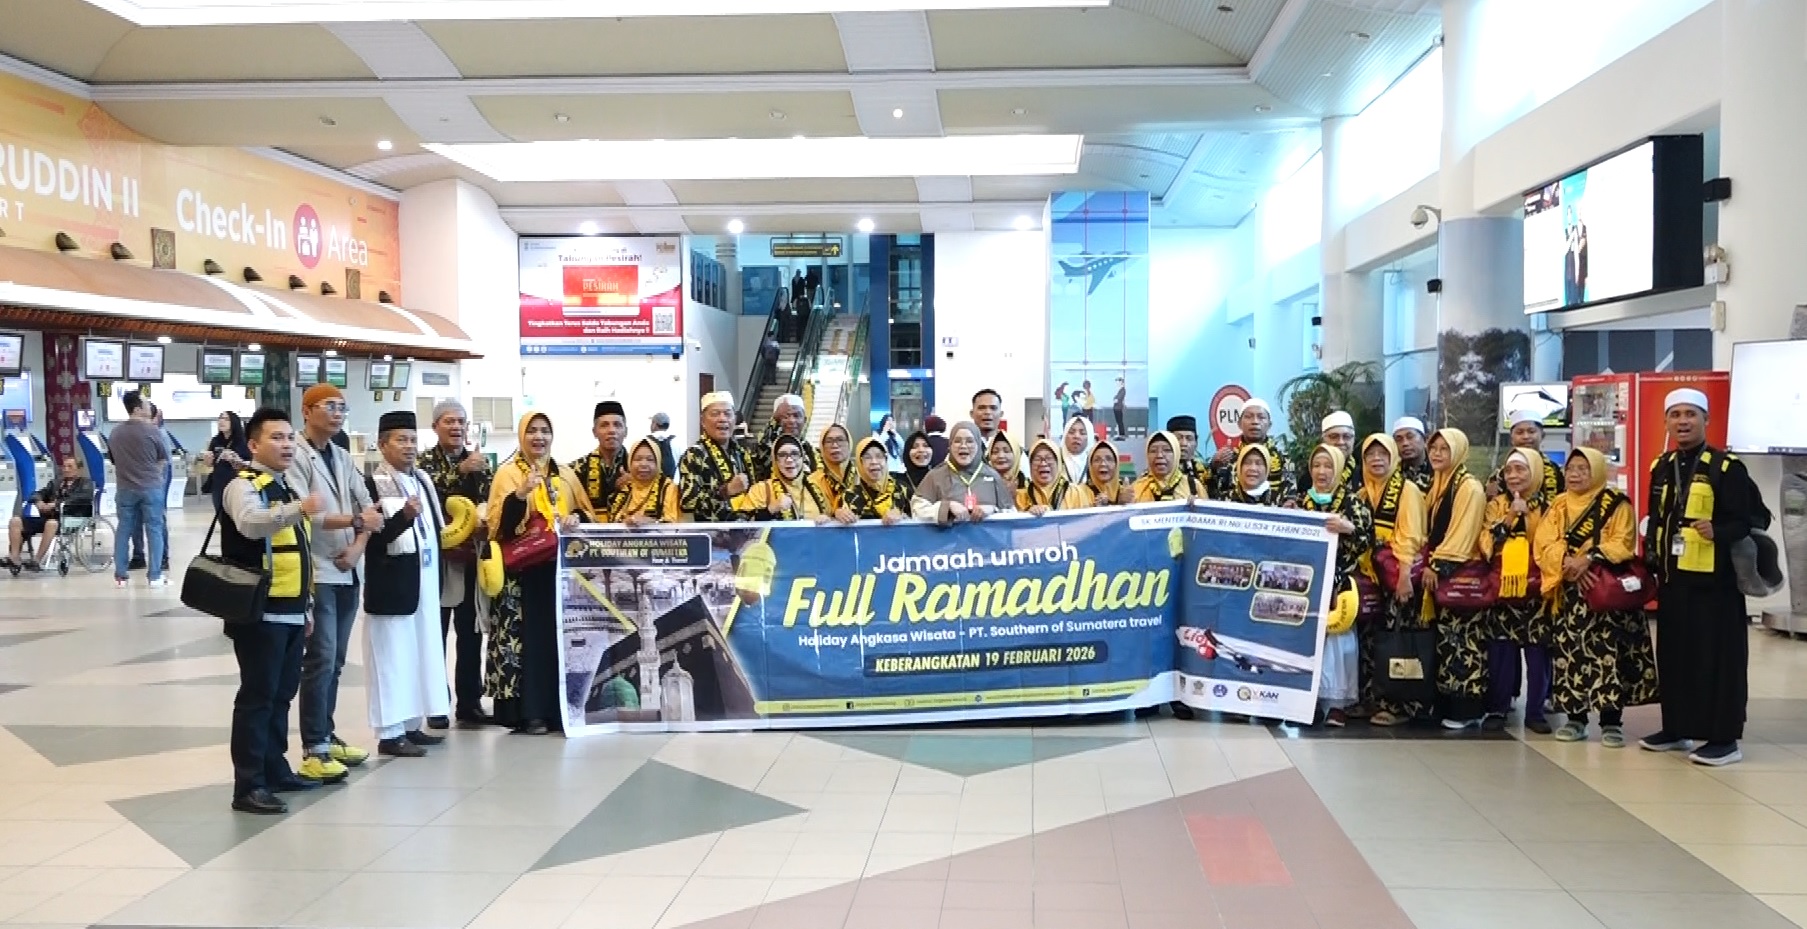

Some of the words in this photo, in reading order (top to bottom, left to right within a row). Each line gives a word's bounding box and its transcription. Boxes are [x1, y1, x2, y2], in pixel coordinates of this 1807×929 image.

[0, 142, 113, 212] UDDIN
[122, 176, 139, 218] II
[176, 188, 287, 250] Check-In
[327, 224, 368, 266] Area
[873, 549, 984, 574] Jamaah
[990, 541, 1078, 566] umroh
[783, 572, 877, 628] Full
[888, 559, 1170, 624] Ramadhan
[798, 633, 847, 648] Holiday
[850, 631, 907, 647] Angkasa
[910, 629, 956, 642] Wisata
[969, 626, 988, 638] PT.
[990, 622, 1048, 638] Southern
[1051, 620, 1064, 633] of
[1066, 617, 1126, 632] Sumatera
[1130, 615, 1163, 628] travel
[875, 653, 980, 673] KEBERANGKATAN
[986, 652, 1000, 666] 19
[1003, 648, 1061, 665] FEBRUARI
[1066, 645, 1096, 661] 2026
[1260, 690, 1280, 700] KAN
